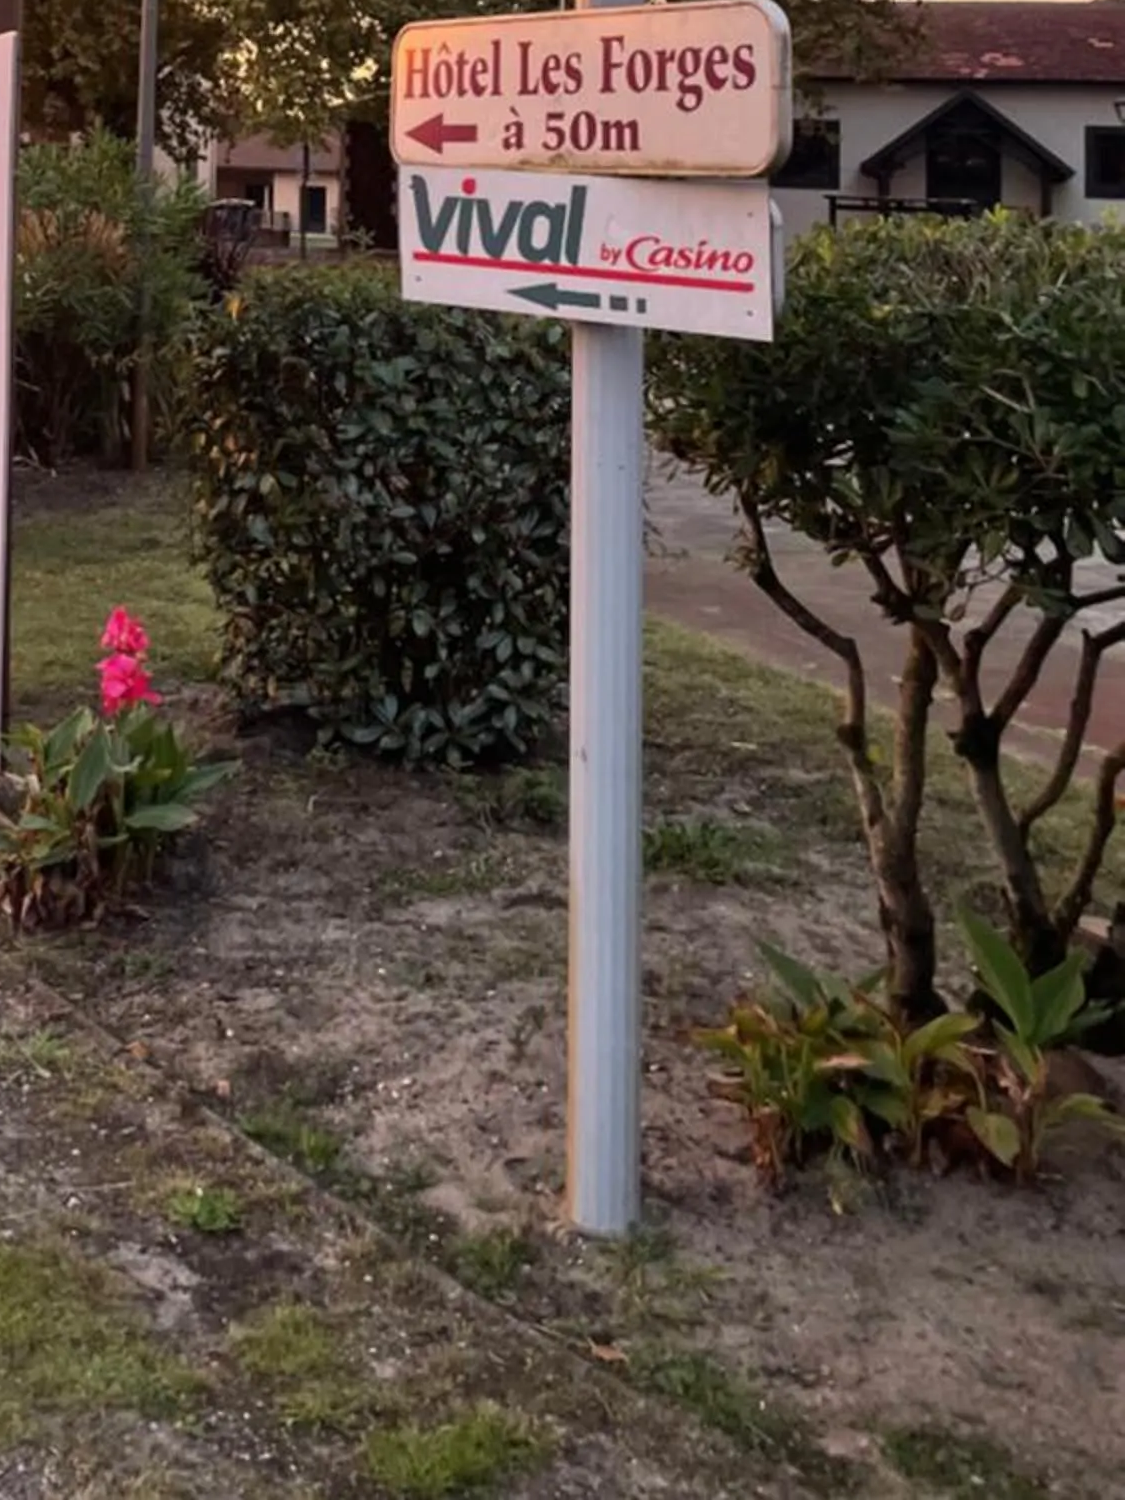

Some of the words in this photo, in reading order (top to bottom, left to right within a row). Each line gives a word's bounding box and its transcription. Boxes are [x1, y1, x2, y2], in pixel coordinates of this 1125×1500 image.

[404, 40, 502, 99] Hôtel
[519, 41, 583, 96] Les
[600, 35, 756, 112] Forges
[502, 107, 525, 151] à
[541, 111, 640, 152] 50m
[599, 245, 622, 266] by
[626, 237, 754, 274] Casino
